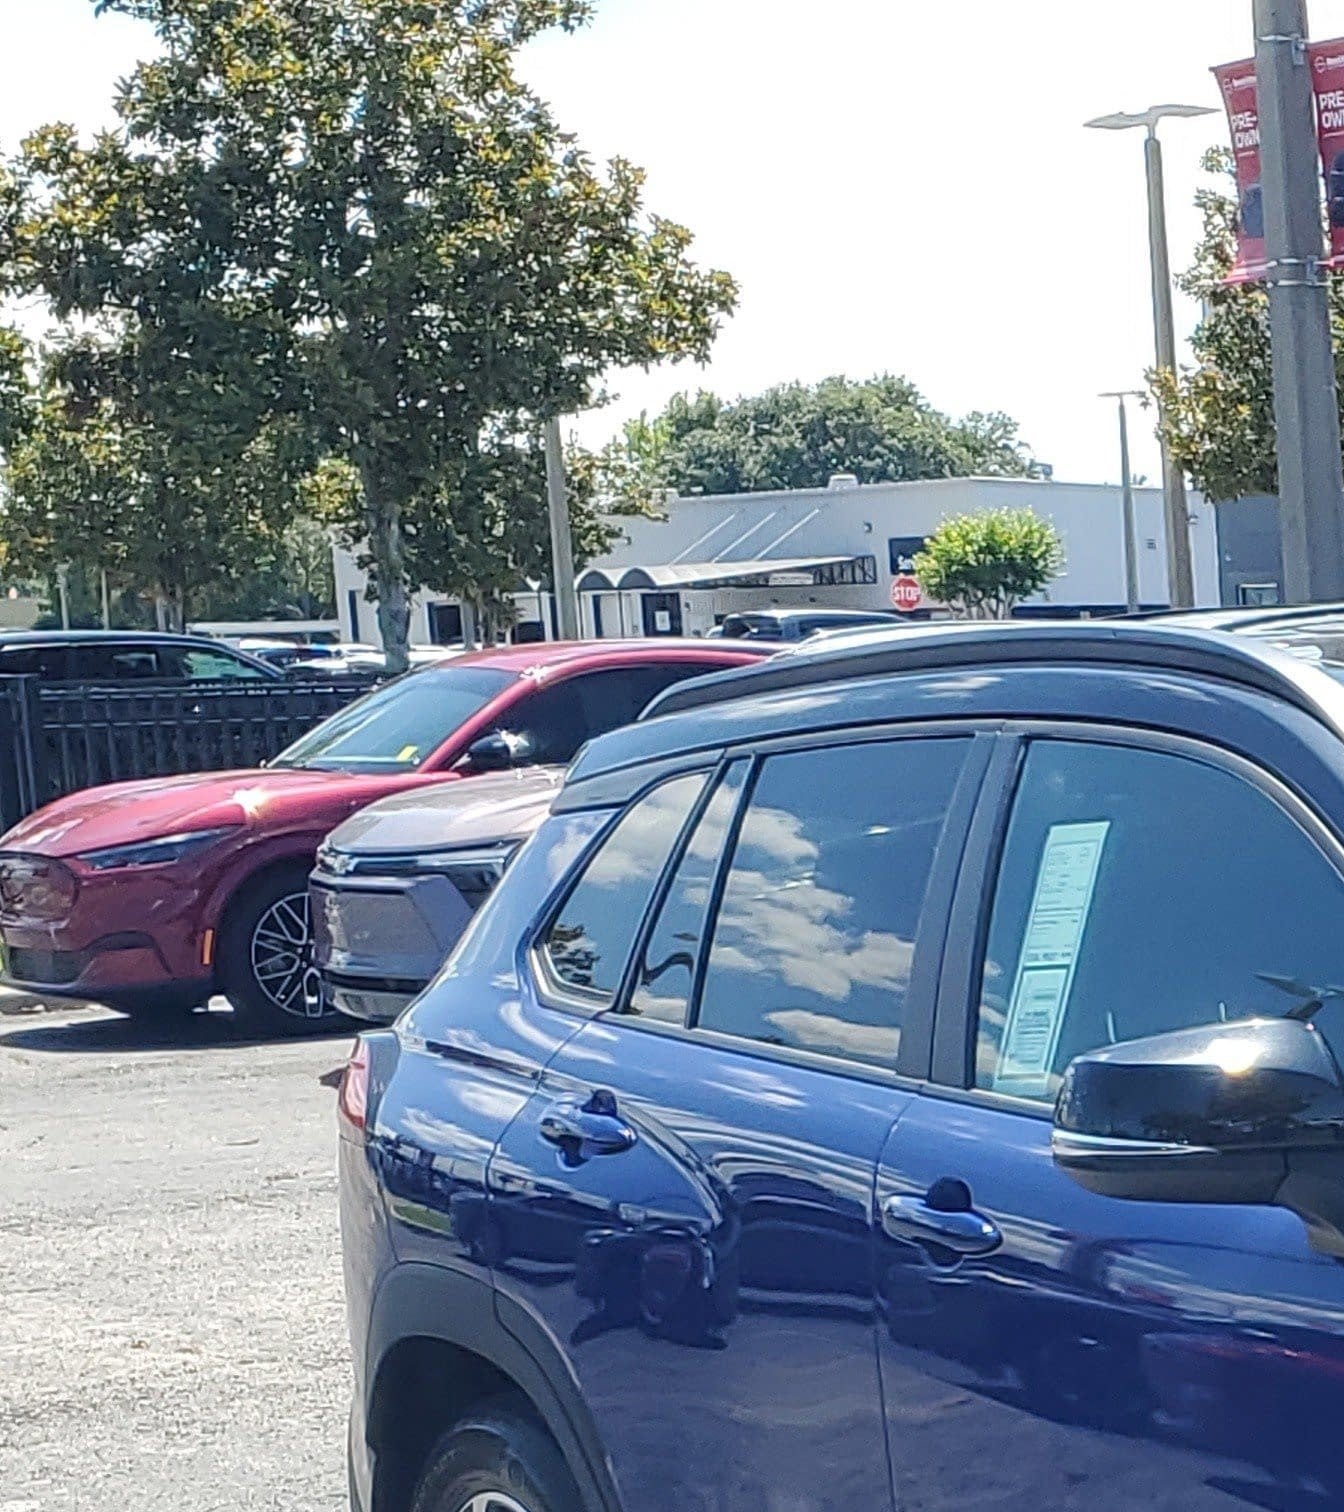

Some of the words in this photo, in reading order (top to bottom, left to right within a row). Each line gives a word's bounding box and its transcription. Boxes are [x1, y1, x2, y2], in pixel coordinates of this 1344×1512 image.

[1231, 111, 1257, 131] PRE-
[1235, 129, 1260, 148] OWN
[894, 586, 920, 601] STOP
